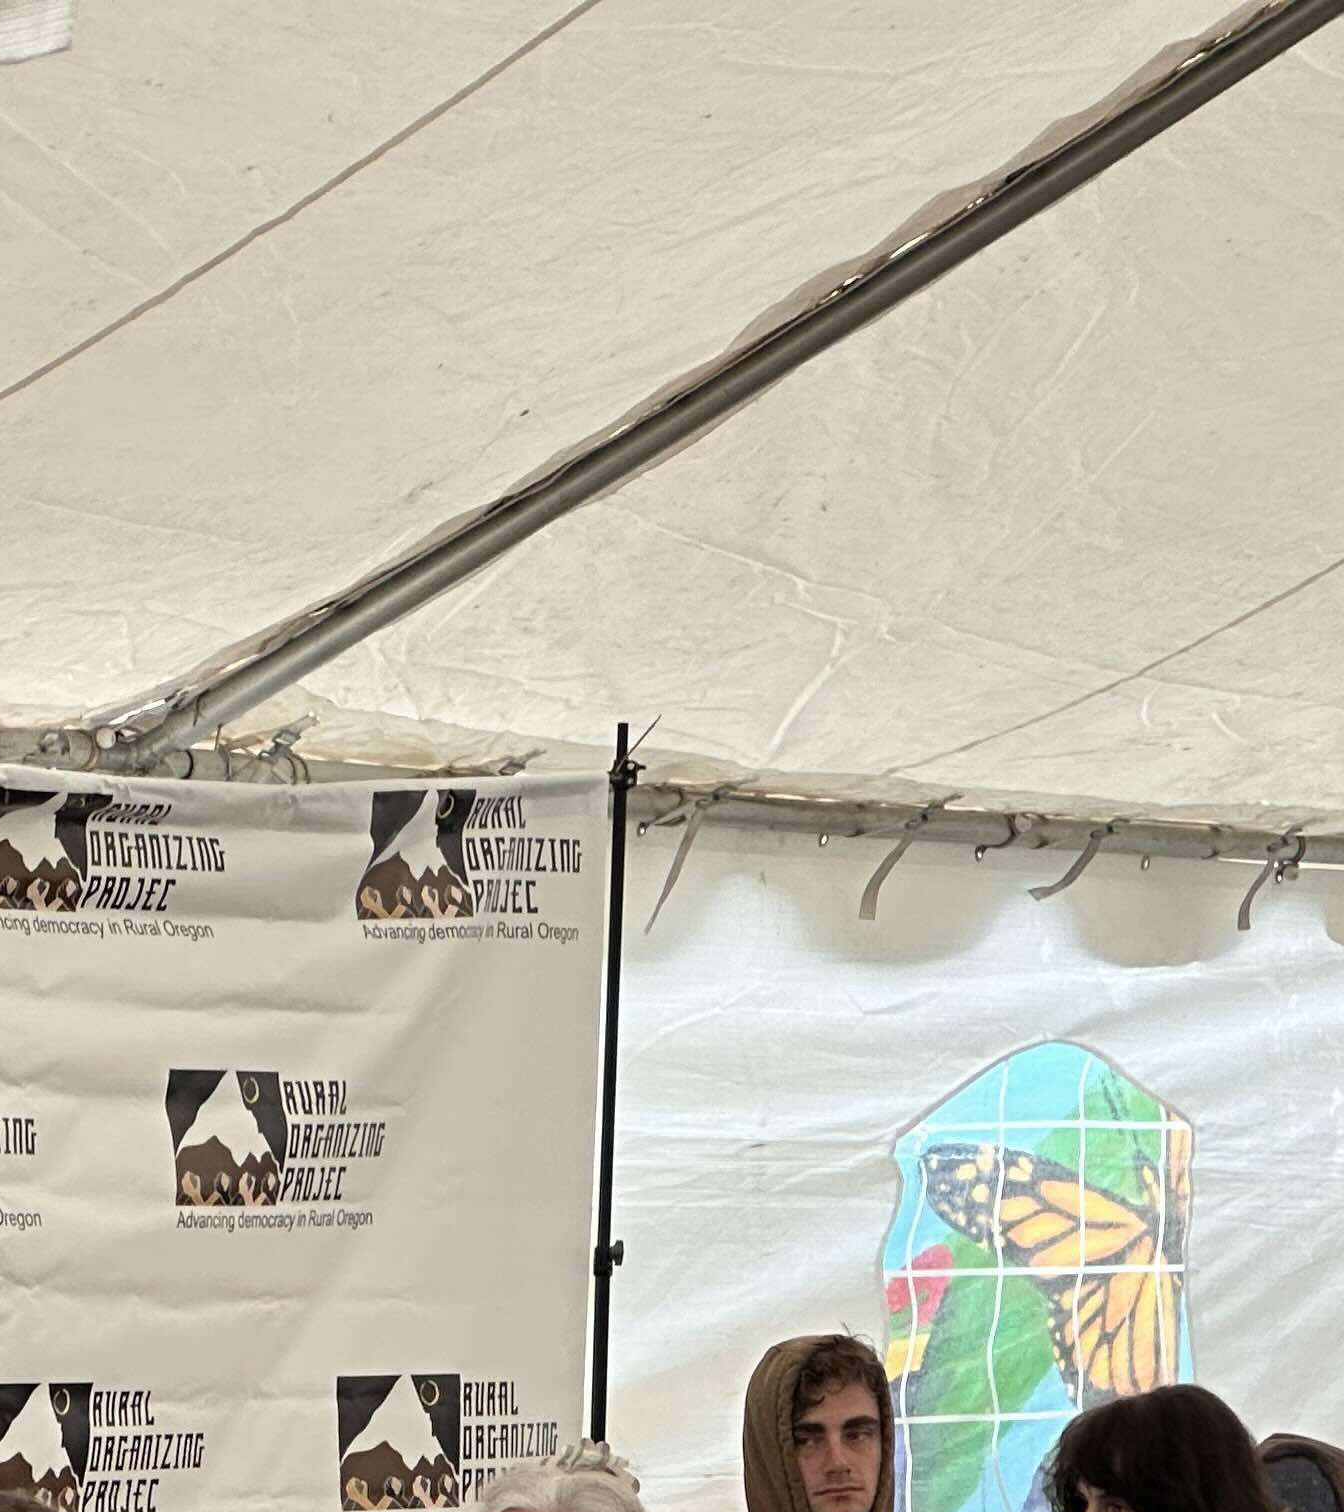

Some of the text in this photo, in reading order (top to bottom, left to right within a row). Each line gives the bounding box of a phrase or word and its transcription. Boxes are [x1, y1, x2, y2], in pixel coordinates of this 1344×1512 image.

[467, 796, 526, 829] RURAL
[90, 831, 225, 872] ORGANIZING
[465, 837, 582, 873] ORGANIZING
[33, 916, 104, 939] democracy
[109, 920, 121, 934] in
[124, 920, 160, 935] Rural
[164, 921, 214, 941] Oregon
[363, 924, 425, 944] Advancing
[497, 922, 532, 939] Rural
[538, 923, 578, 944] Oregon
[283, 1080, 347, 1115] RURAL
[289, 1123, 386, 1158] ORGANIZING
[177, 1209, 372, 1232] Advancing democracy in Rural Oregon
[93, 1391, 154, 1426] RURAL
[463, 1381, 519, 1416] RURAL
[89, 1433, 205, 1471] ORGANIZING
[463, 1423, 557, 1460] ORGANIZING
